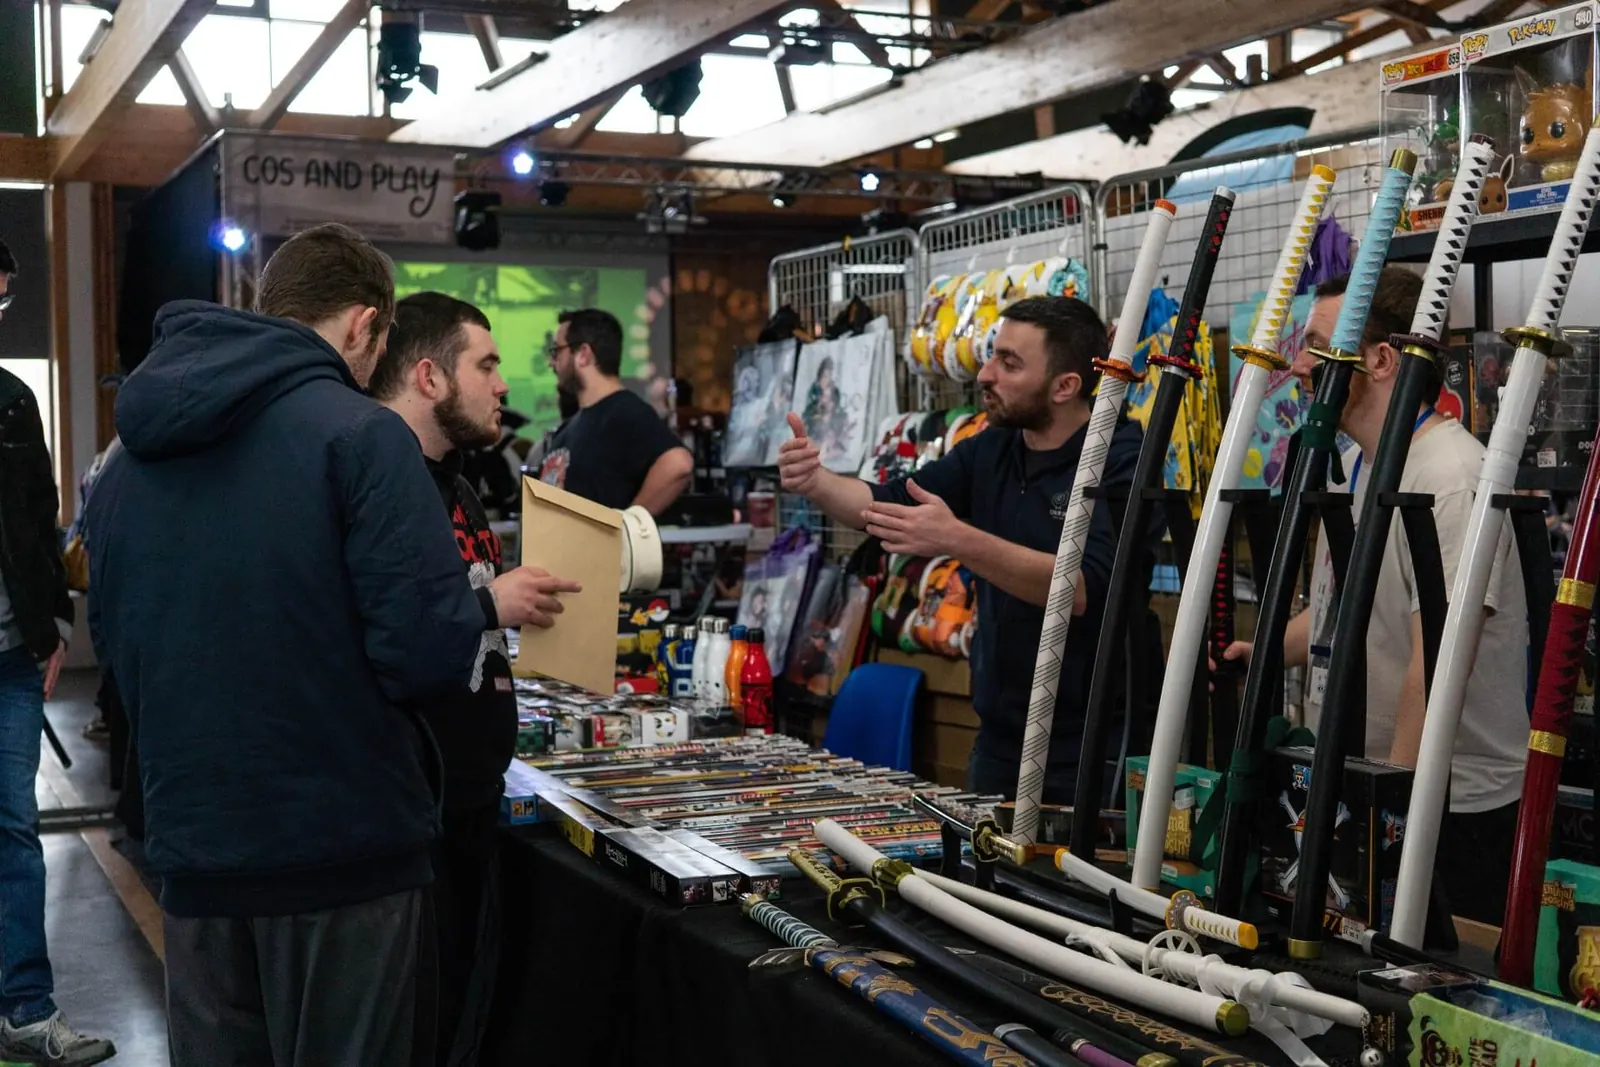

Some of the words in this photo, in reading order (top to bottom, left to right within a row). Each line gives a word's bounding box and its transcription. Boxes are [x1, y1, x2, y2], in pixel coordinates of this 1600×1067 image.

[1461, 33, 1489, 57] POP!
[243, 154, 296, 187] COS
[304, 157, 363, 191] AND
[371, 162, 440, 218] PLAY
